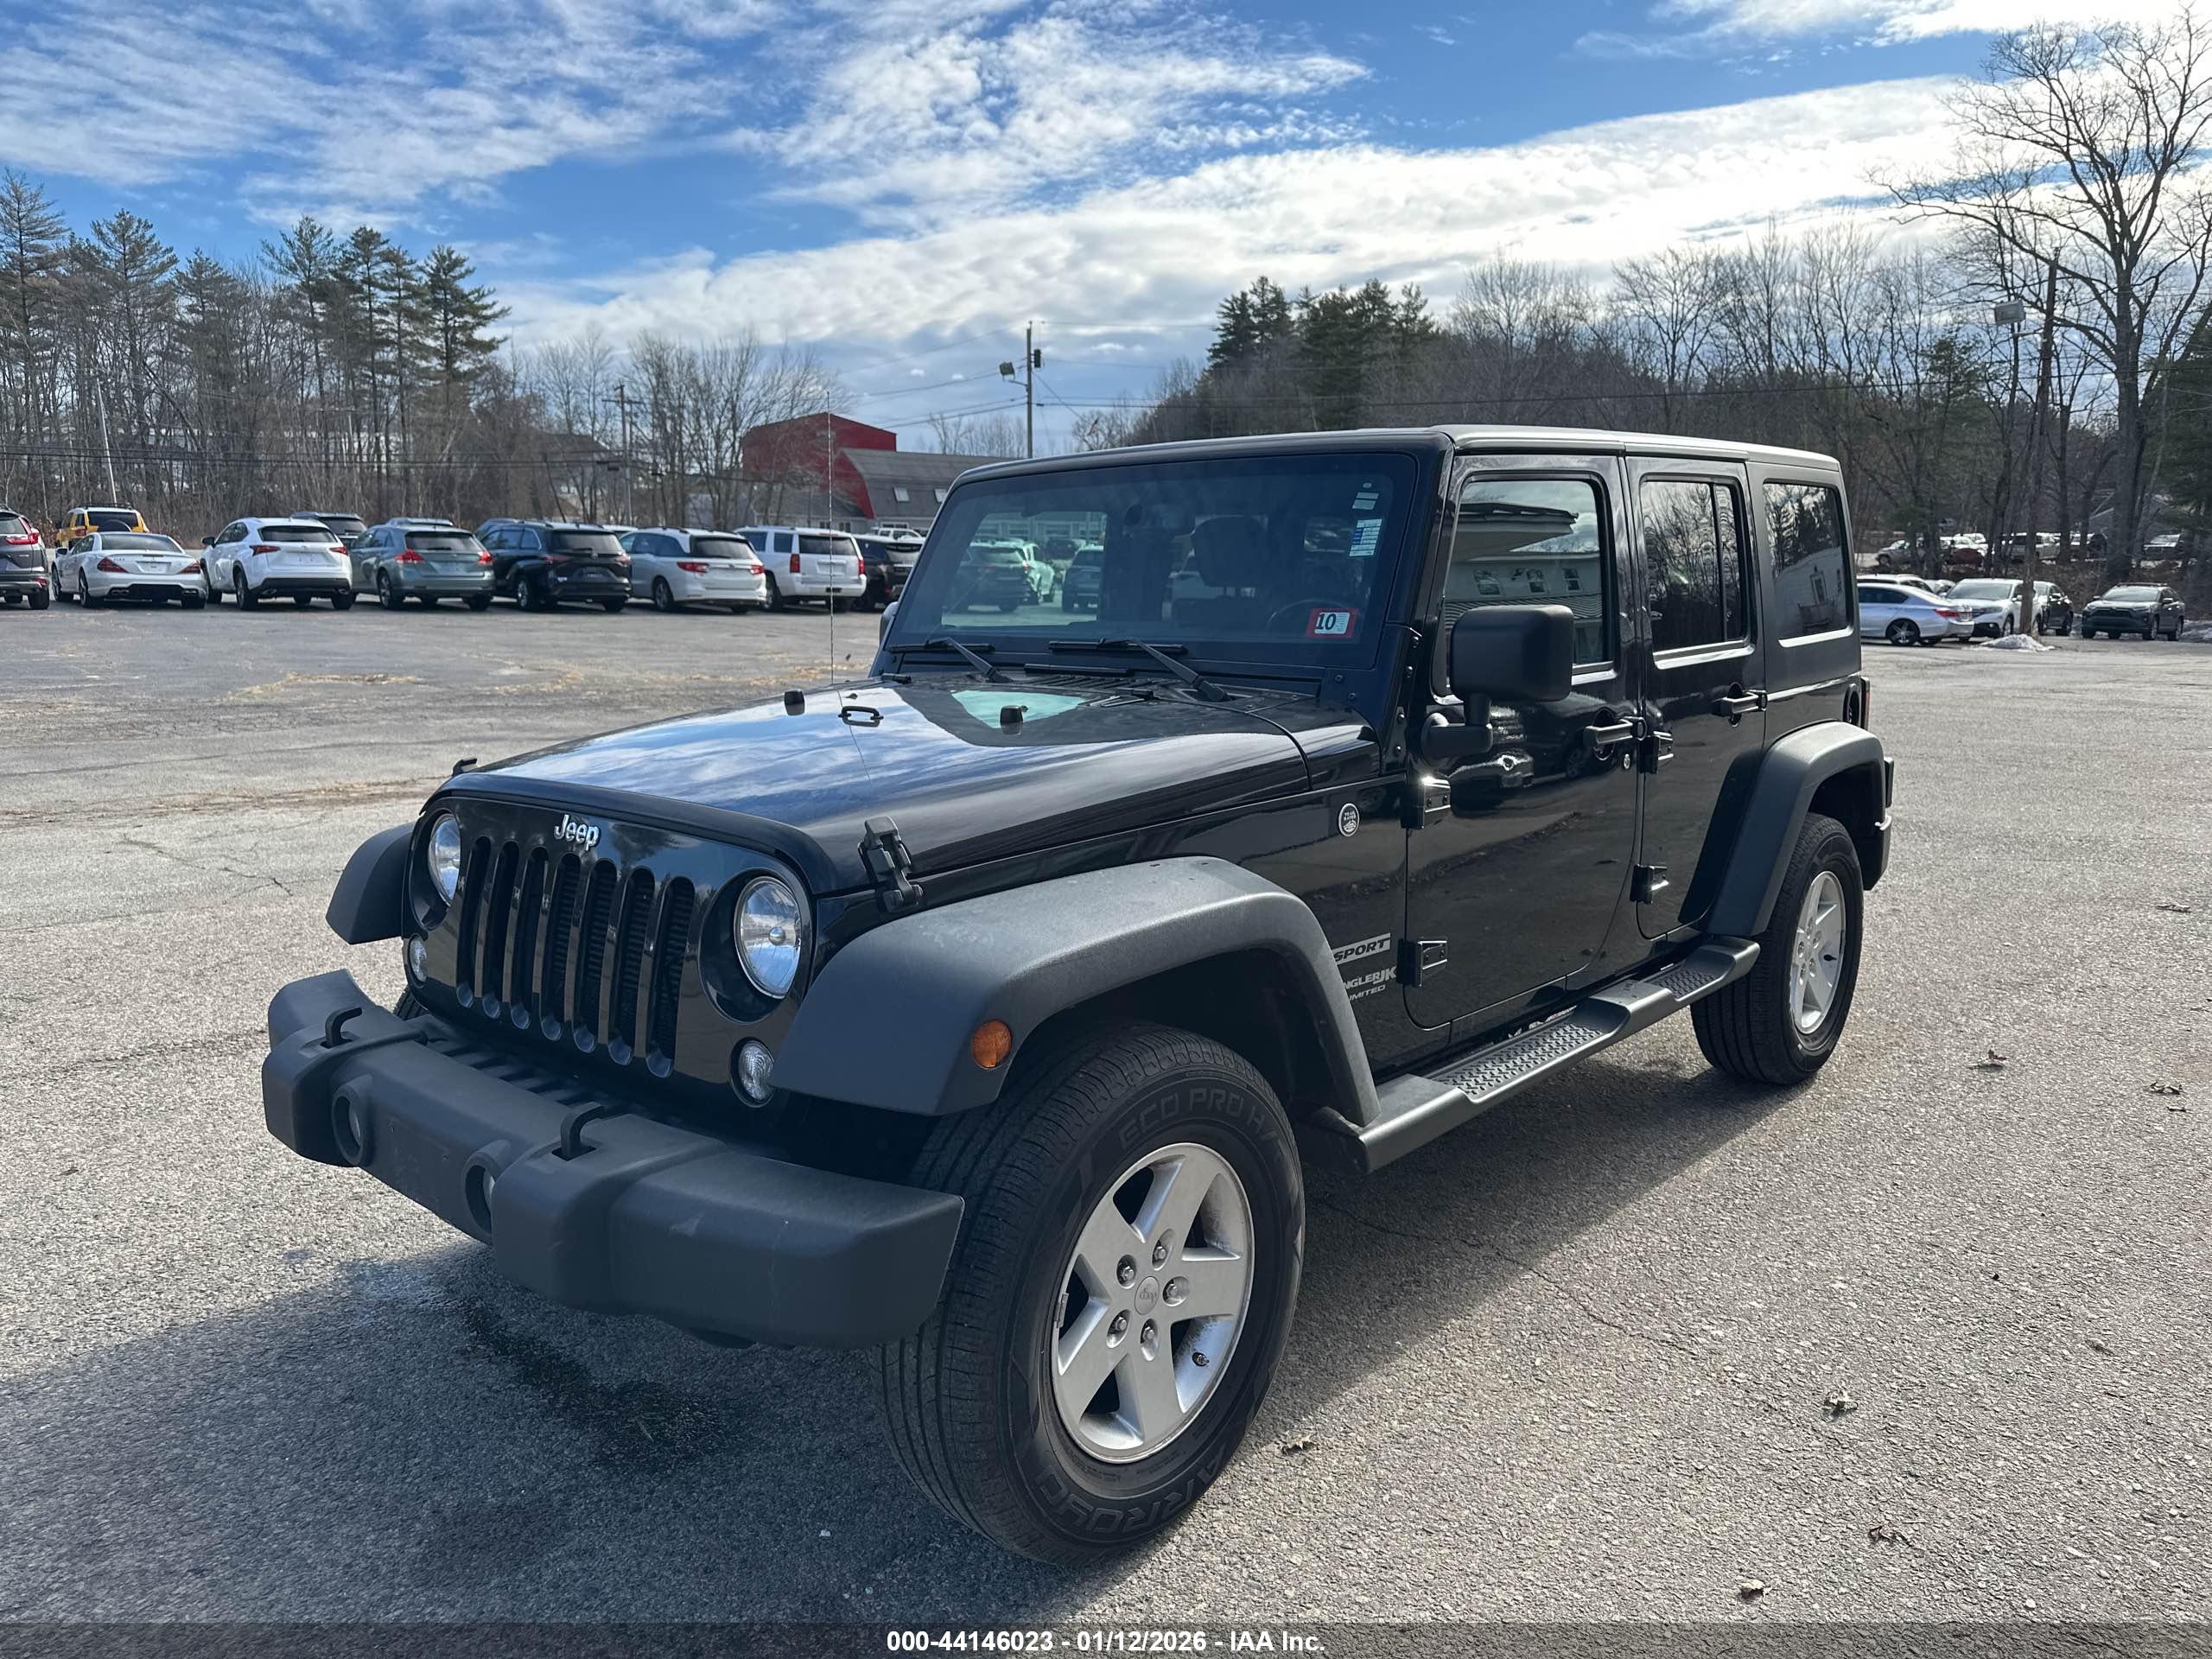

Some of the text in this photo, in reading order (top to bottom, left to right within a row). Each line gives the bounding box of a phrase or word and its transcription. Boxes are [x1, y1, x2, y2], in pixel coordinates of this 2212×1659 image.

[1315, 613, 1337, 631] 10
[554, 814, 600, 851] Jeep
[1334, 938, 1388, 962] SPORT
[1344, 971, 1381, 990] NGLER
[1349, 984, 1386, 1001] IMITED
[1119, 1092, 1179, 1151] ECO
[1189, 1087, 1244, 1117] PRO
